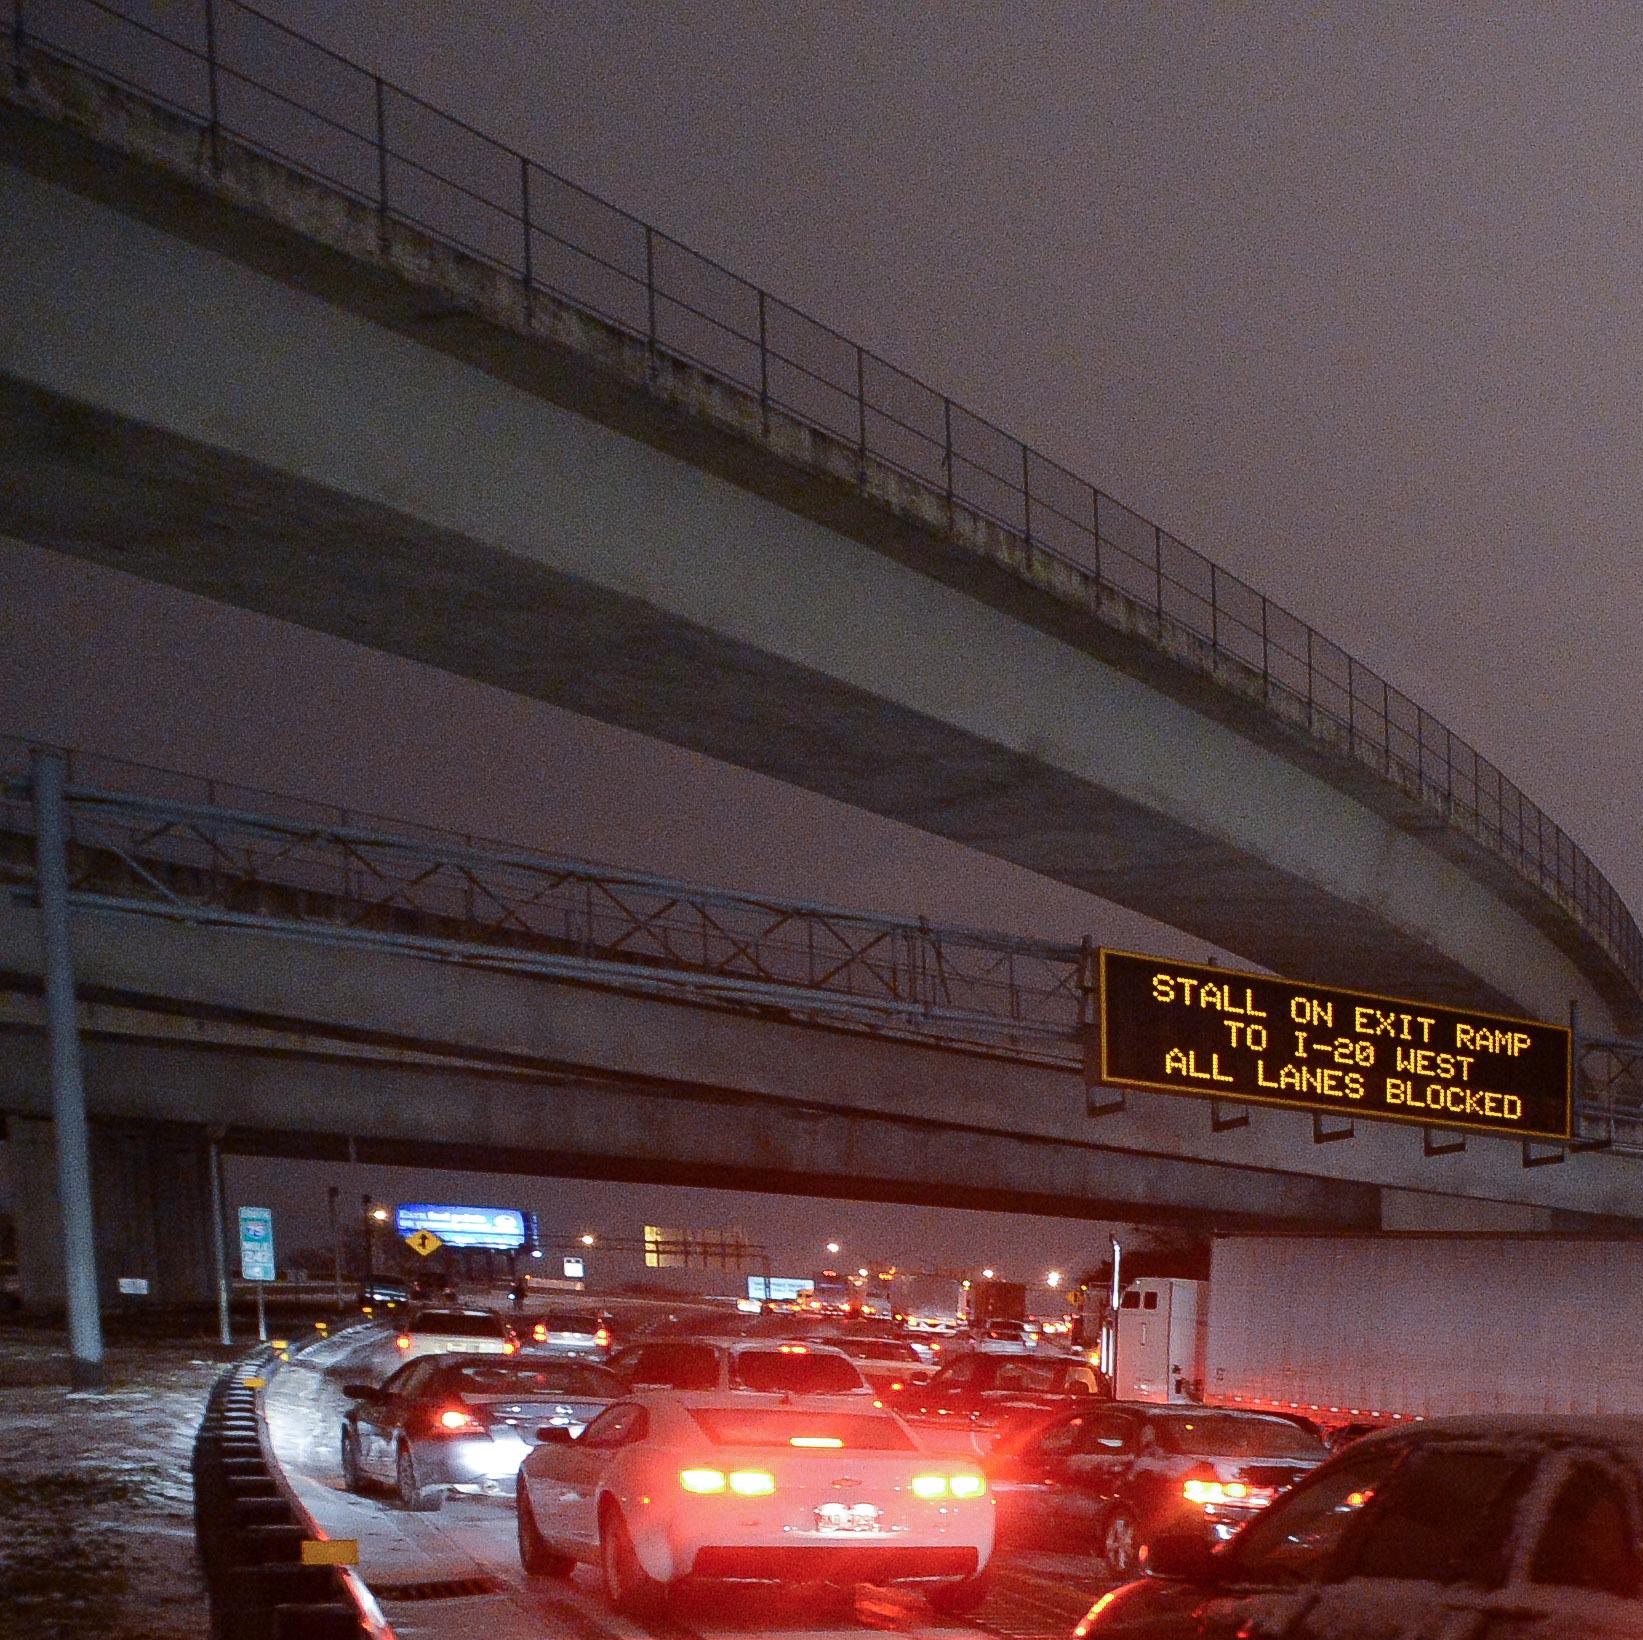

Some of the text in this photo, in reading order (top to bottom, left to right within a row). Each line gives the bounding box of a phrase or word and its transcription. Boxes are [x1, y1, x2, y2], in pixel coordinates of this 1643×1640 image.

[1152, 973, 1532, 1057] STALL ON EXIT RAMP
[1223, 1020, 1475, 1081] TO I-20 WEST
[1165, 1048, 1523, 1120] ALL LANES BLOCKED
